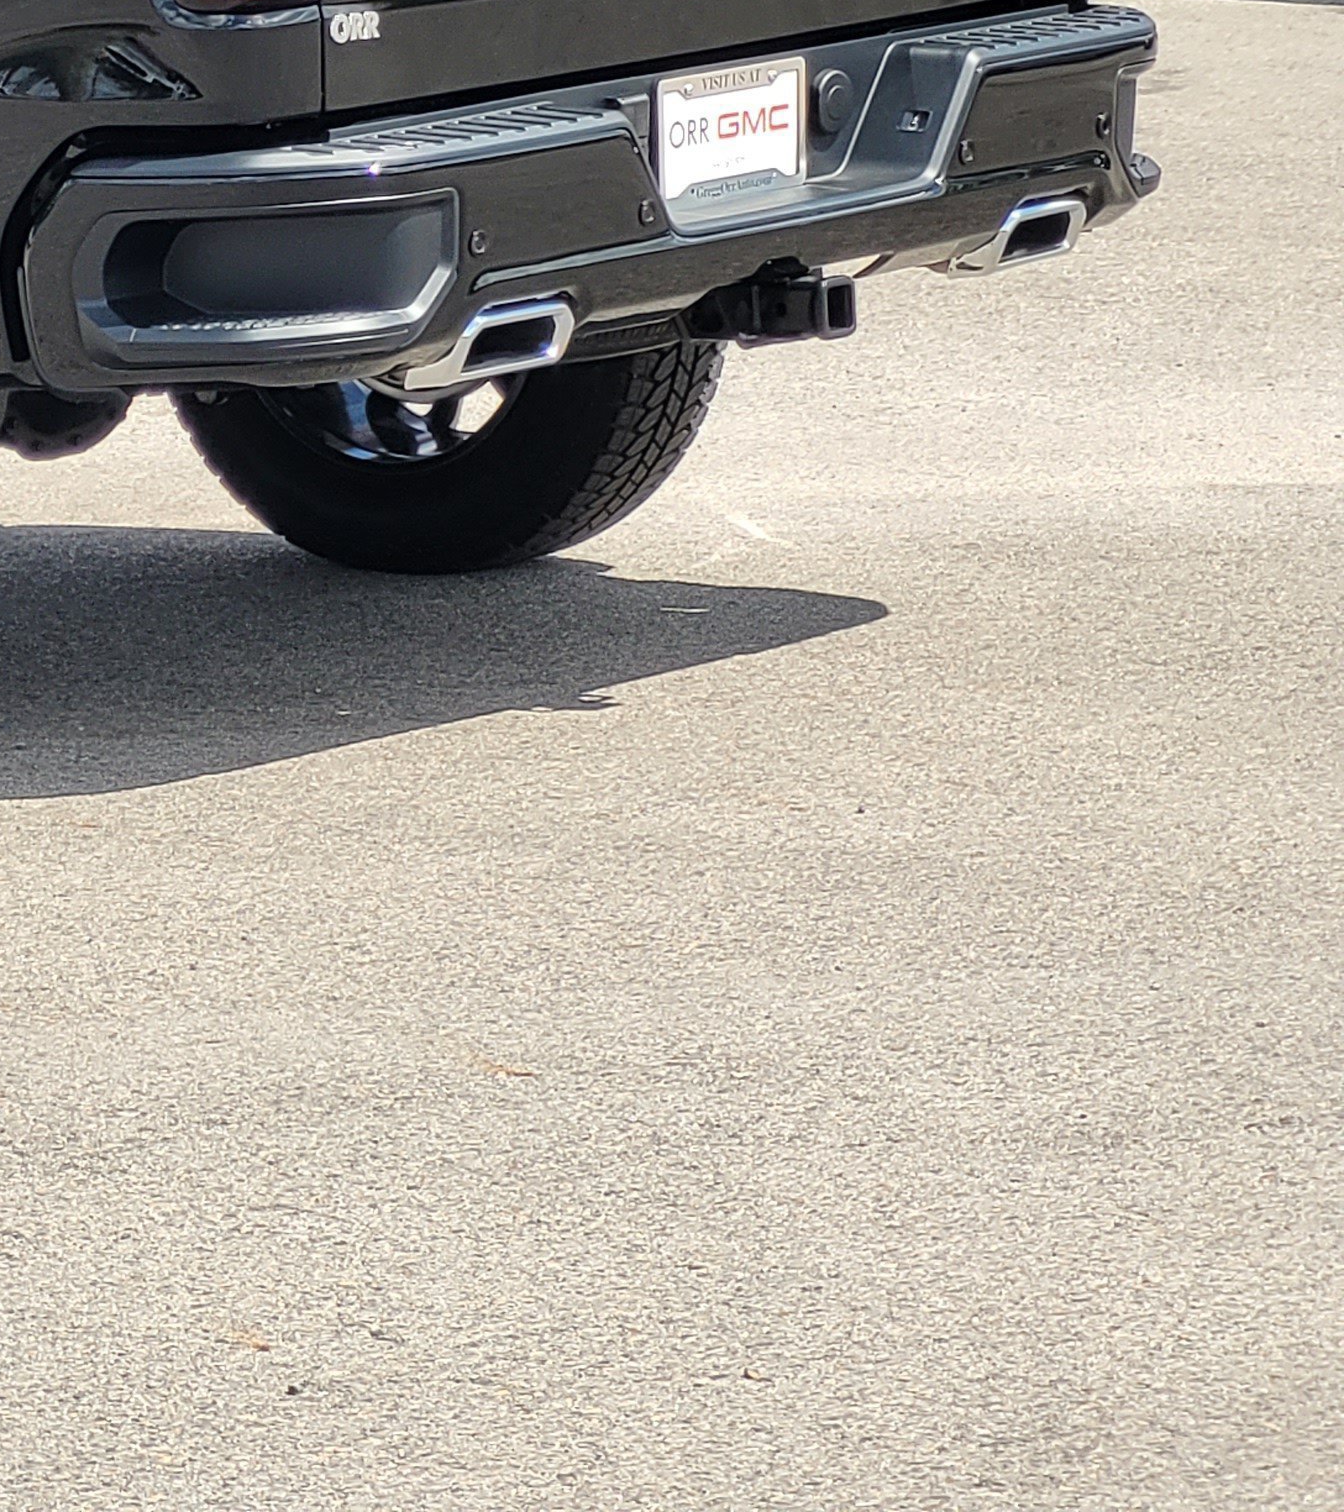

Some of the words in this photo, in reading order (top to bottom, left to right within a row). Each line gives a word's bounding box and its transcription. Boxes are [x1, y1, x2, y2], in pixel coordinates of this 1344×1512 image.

[330, 11, 381, 44] ORR
[702, 72, 730, 90] VISIT
[669, 117, 710, 148] ORR
[718, 104, 789, 139] GMC
